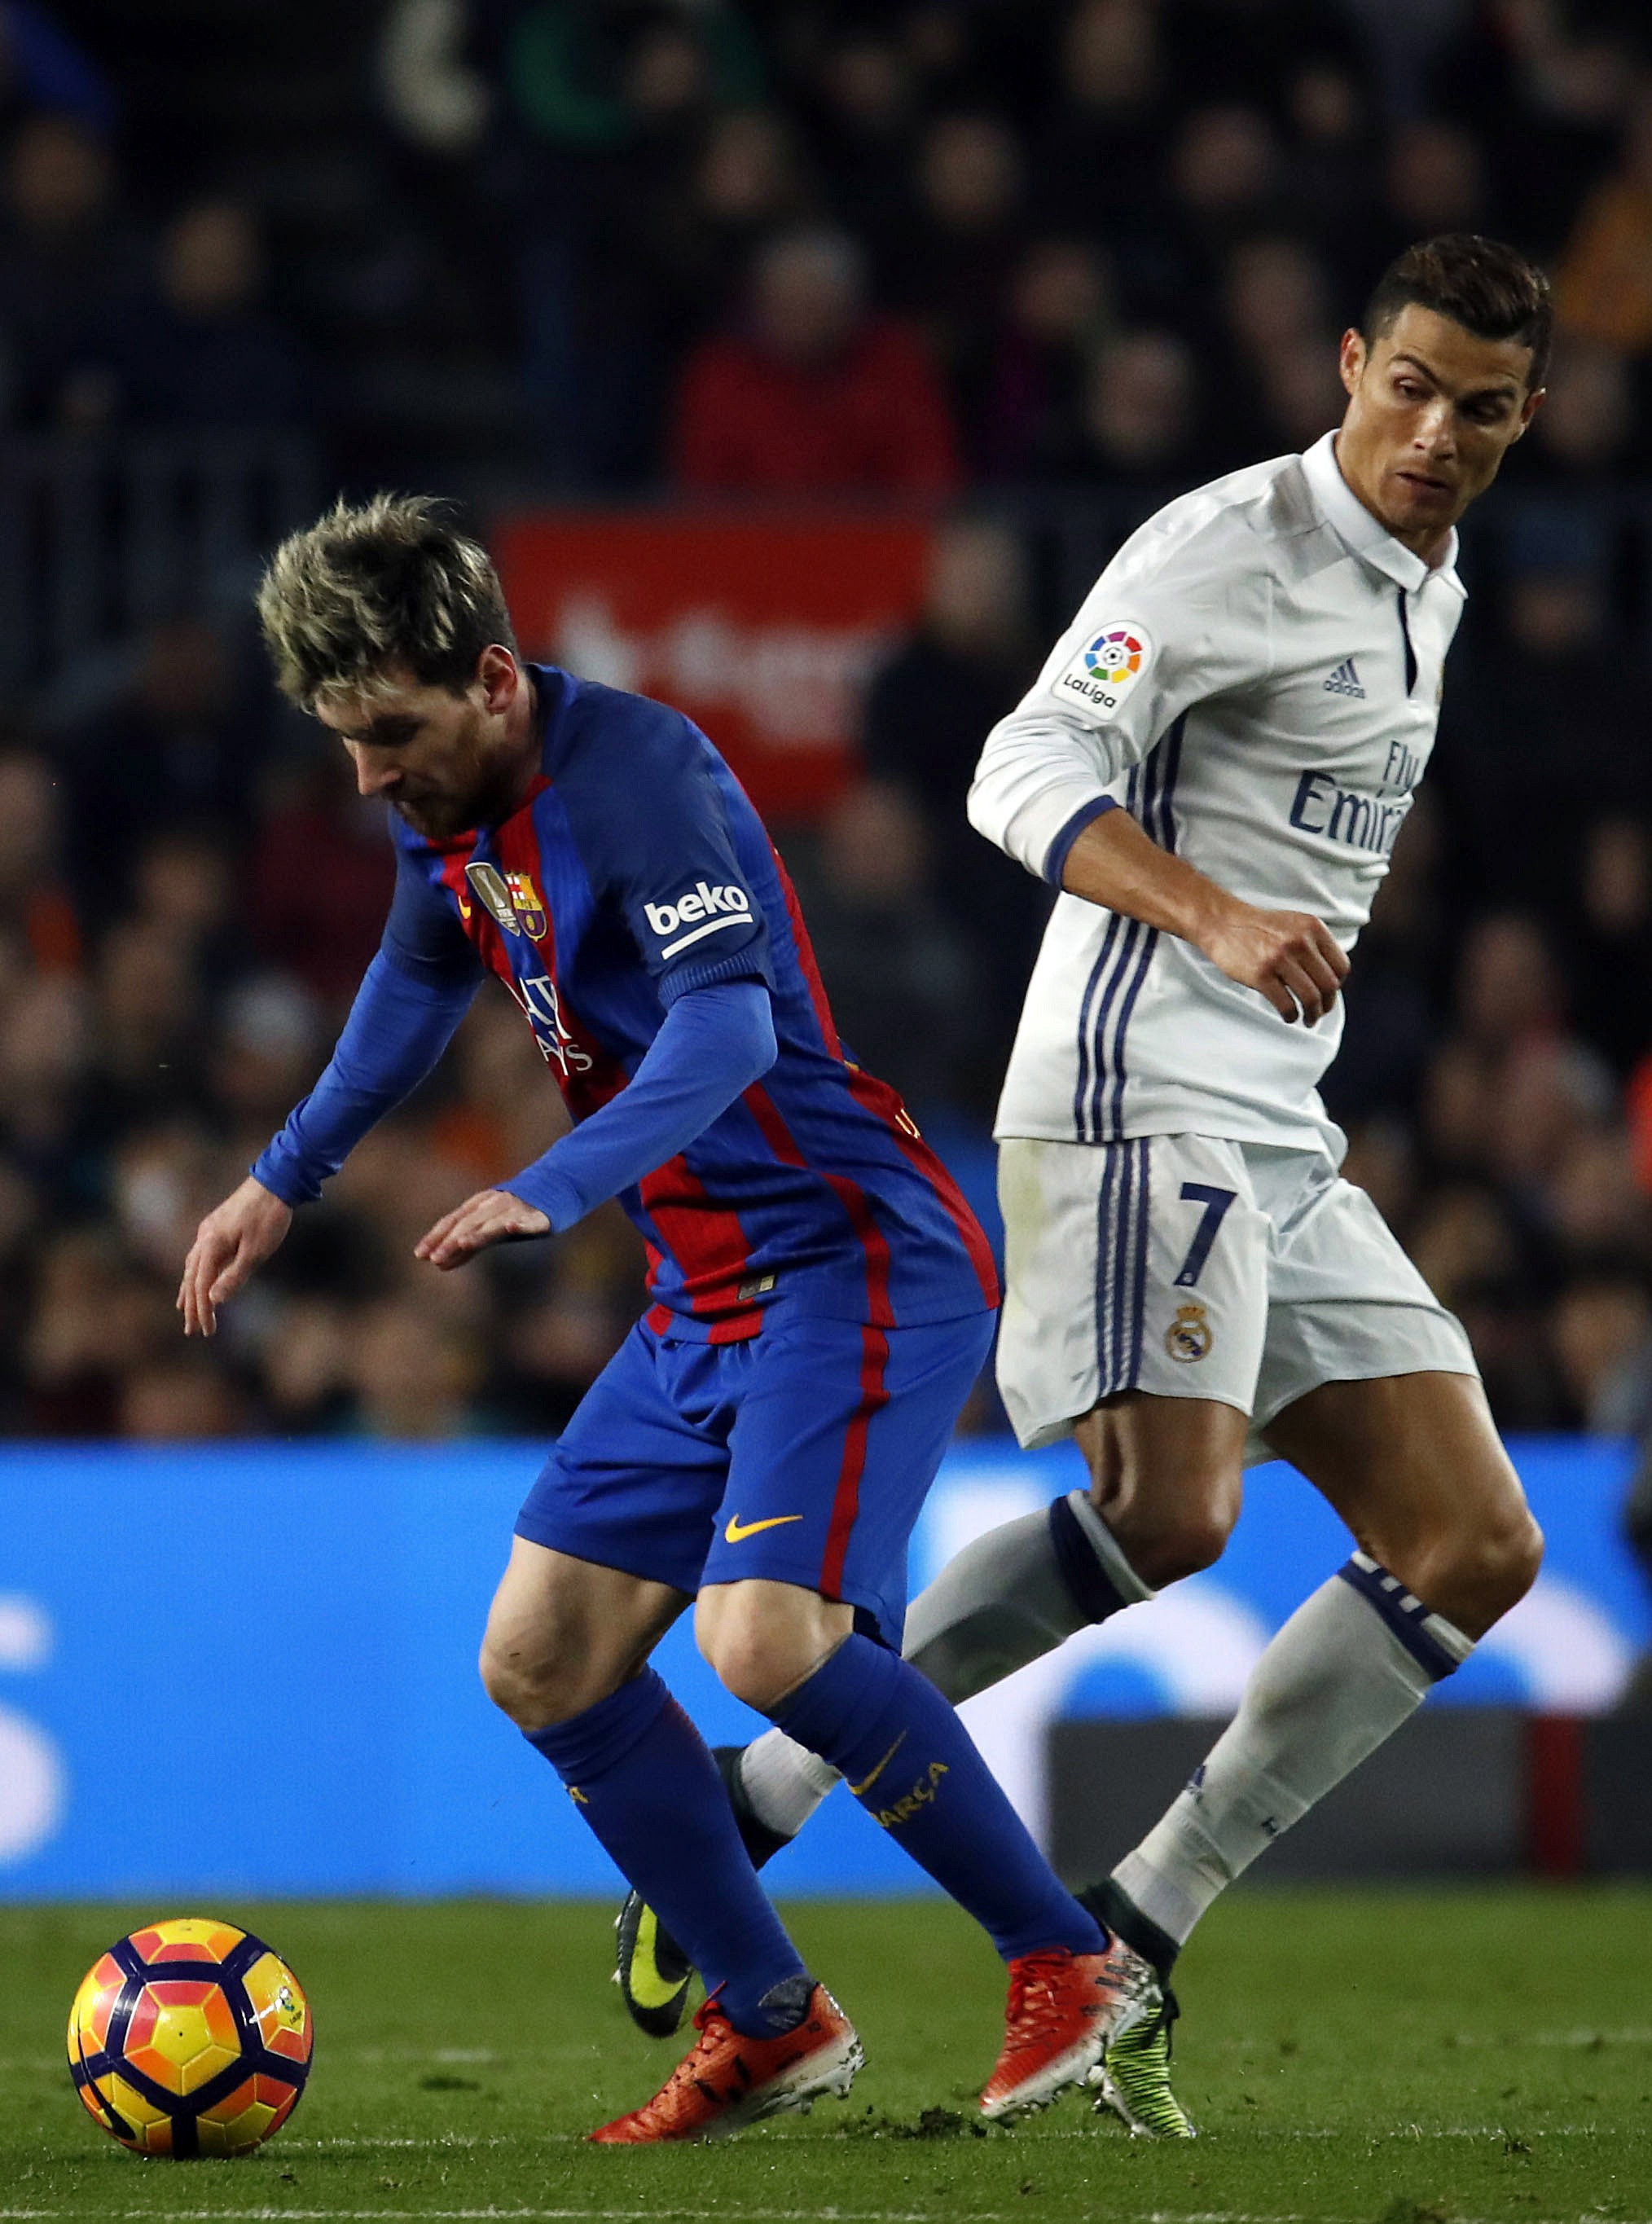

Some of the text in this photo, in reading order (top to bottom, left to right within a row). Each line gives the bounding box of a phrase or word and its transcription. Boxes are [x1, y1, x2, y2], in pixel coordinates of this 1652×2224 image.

[1063, 674, 1117, 708] LaLiga
[1323, 679, 1366, 699] adidas
[644, 881, 749, 935] beko
[1174, 1182, 1238, 1286] 7
